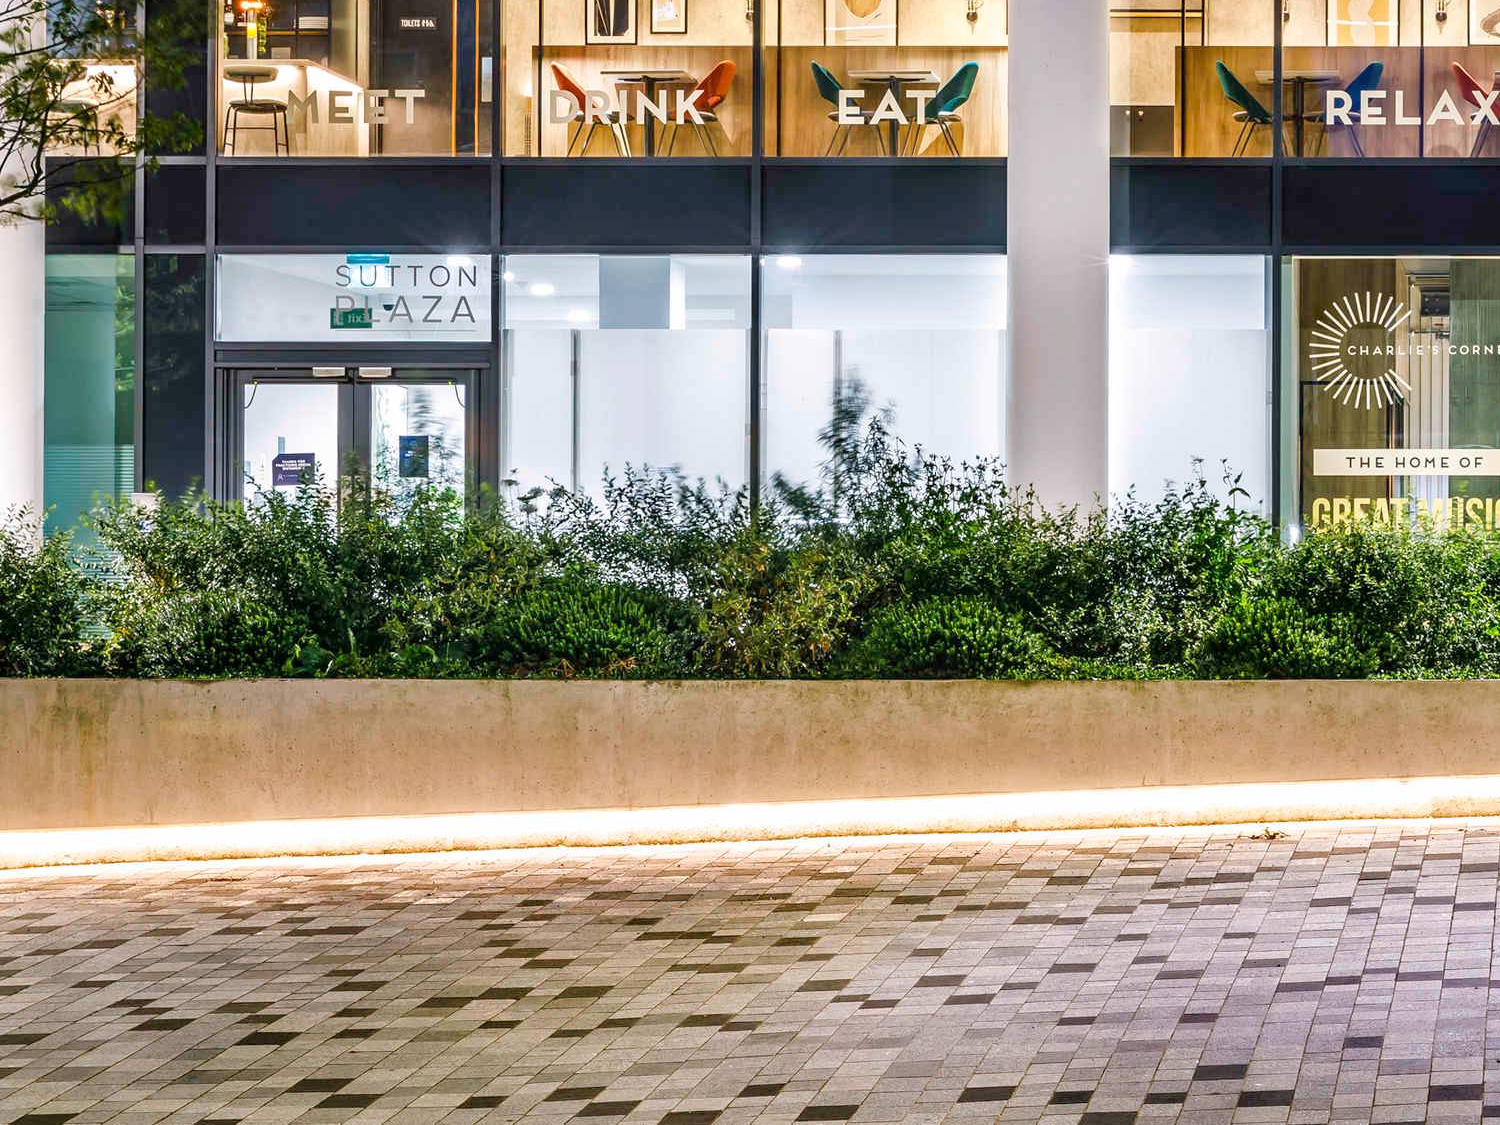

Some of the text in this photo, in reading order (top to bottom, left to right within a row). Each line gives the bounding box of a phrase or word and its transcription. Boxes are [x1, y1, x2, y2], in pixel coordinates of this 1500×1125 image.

[287, 89, 426, 124] MEET
[549, 89, 705, 125] DRINK
[838, 89, 937, 125] EAT
[1326, 89, 1500, 125] RELAX
[335, 265, 477, 287] SUTTON
[335, 295, 476, 324] PLAZA
[1347, 344, 1440, 355] CHARLIE'S
[1346, 457, 1484, 468] THE HOME OF
